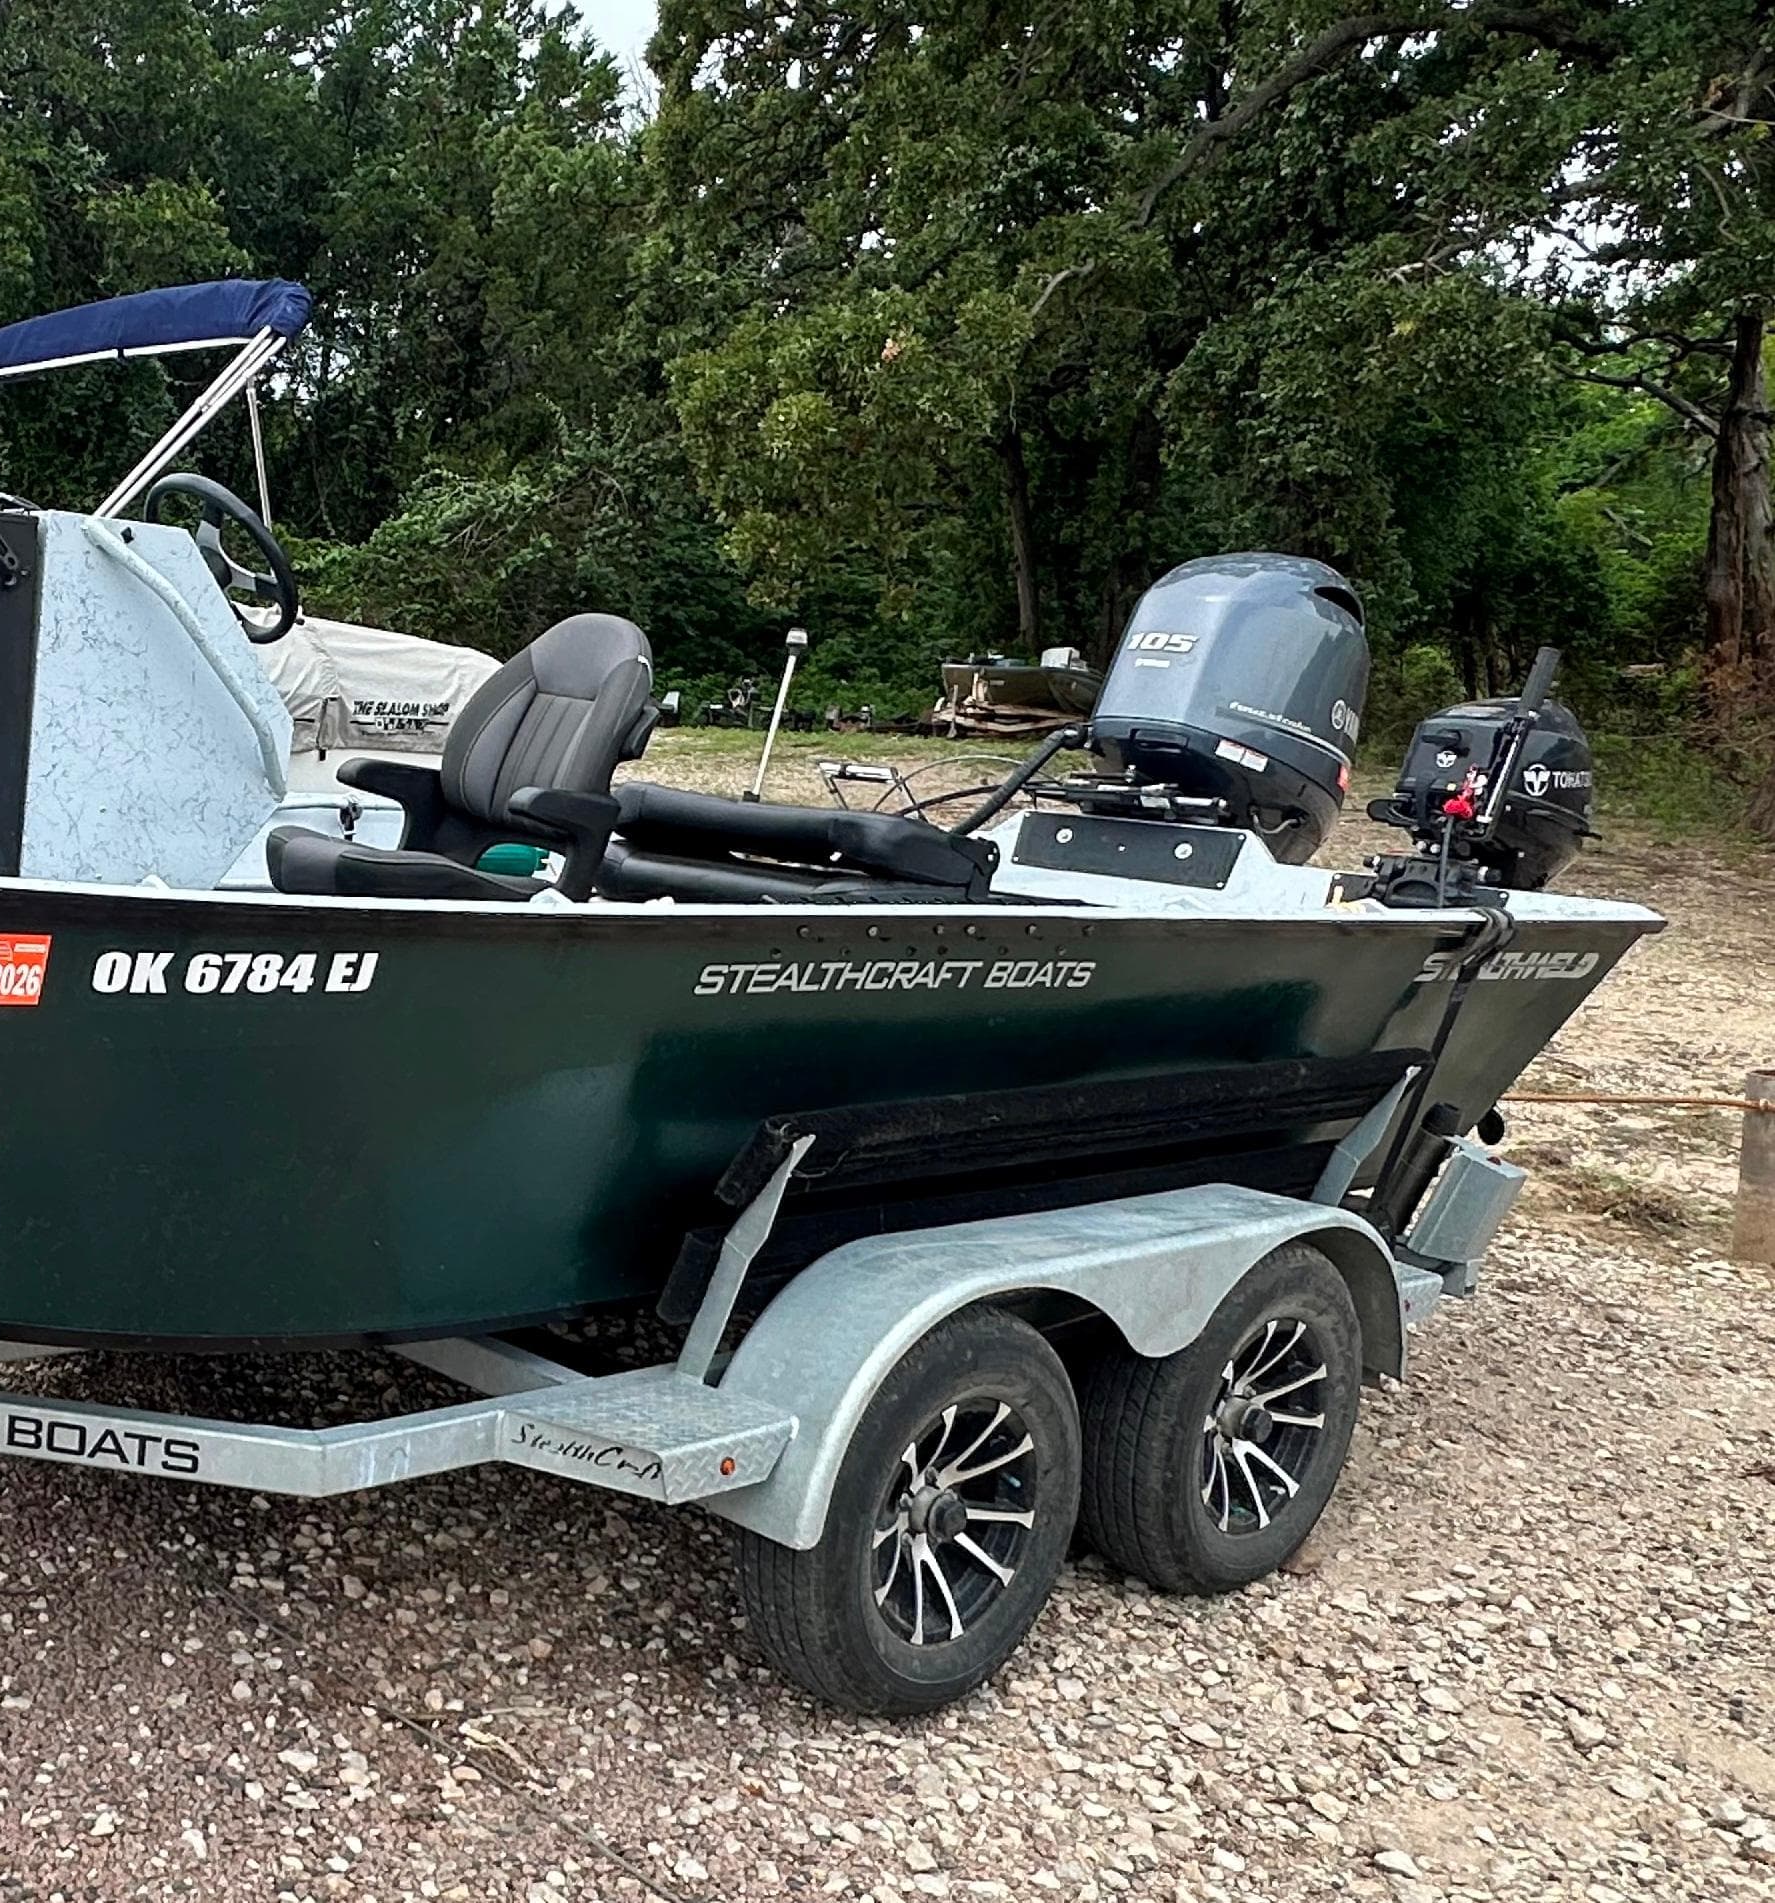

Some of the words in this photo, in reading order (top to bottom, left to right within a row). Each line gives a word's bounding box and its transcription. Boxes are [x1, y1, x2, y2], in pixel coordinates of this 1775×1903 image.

[1127, 632, 1201, 652] 105
[352, 700, 374, 716] THE
[91, 951, 175, 994] OK
[184, 952, 317, 994] 6784
[324, 952, 379, 993] EJ
[693, 961, 983, 995] STEALTHCRAFT
[984, 960, 1097, 989] BOATS
[5, 1413, 200, 1475] BOATS
